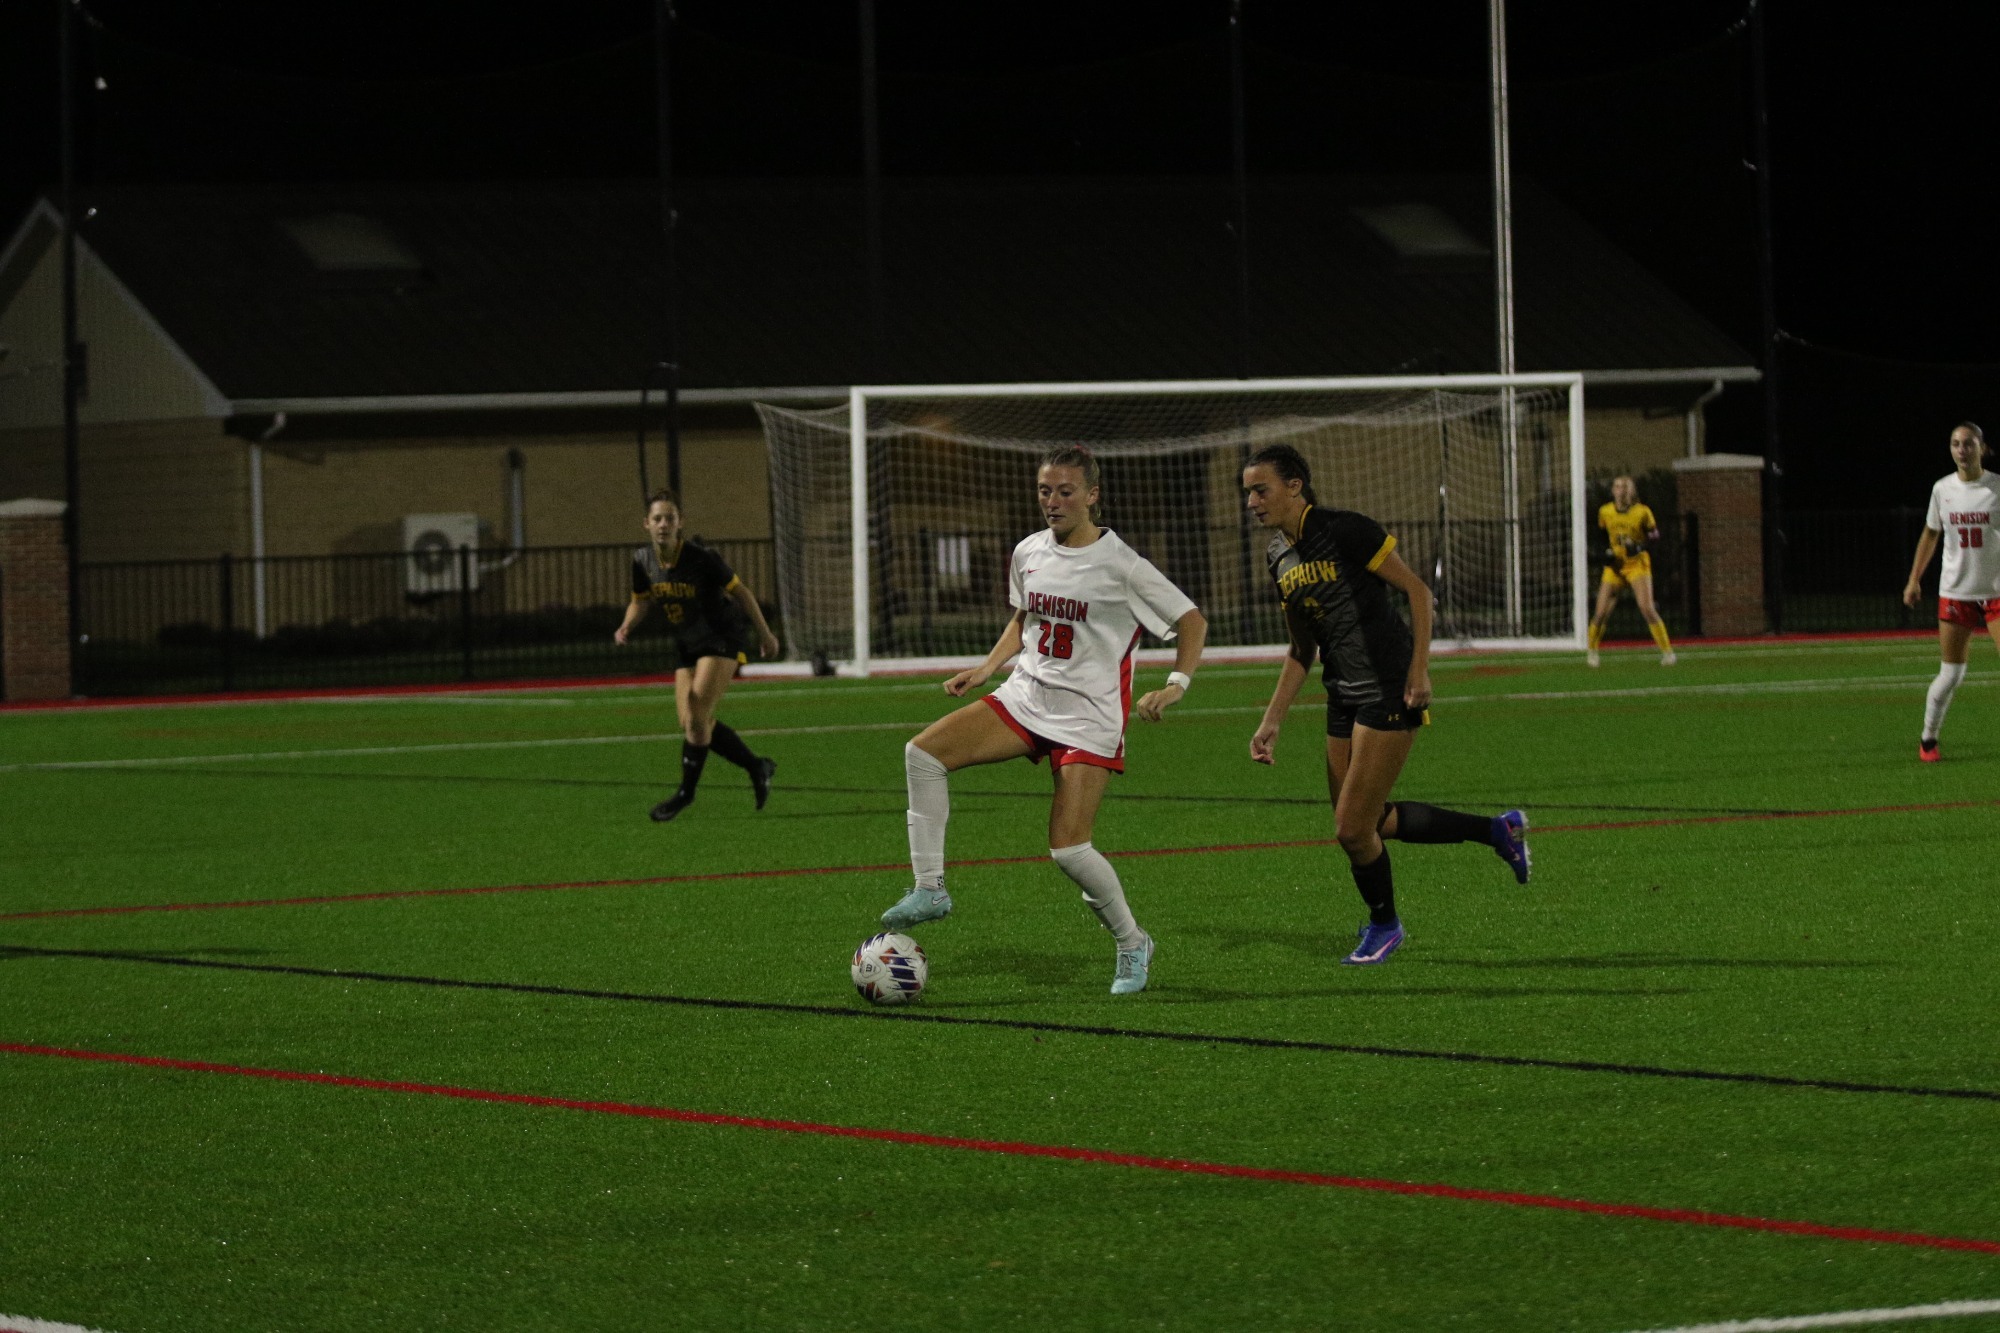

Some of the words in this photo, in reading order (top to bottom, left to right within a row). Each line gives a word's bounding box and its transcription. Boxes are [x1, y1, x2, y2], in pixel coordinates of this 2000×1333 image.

[1949, 512, 1990, 525] DENISON
[1958, 527, 1983, 548] 30
[1028, 591, 1089, 622] DENISON
[1037, 619, 1074, 660] 28
